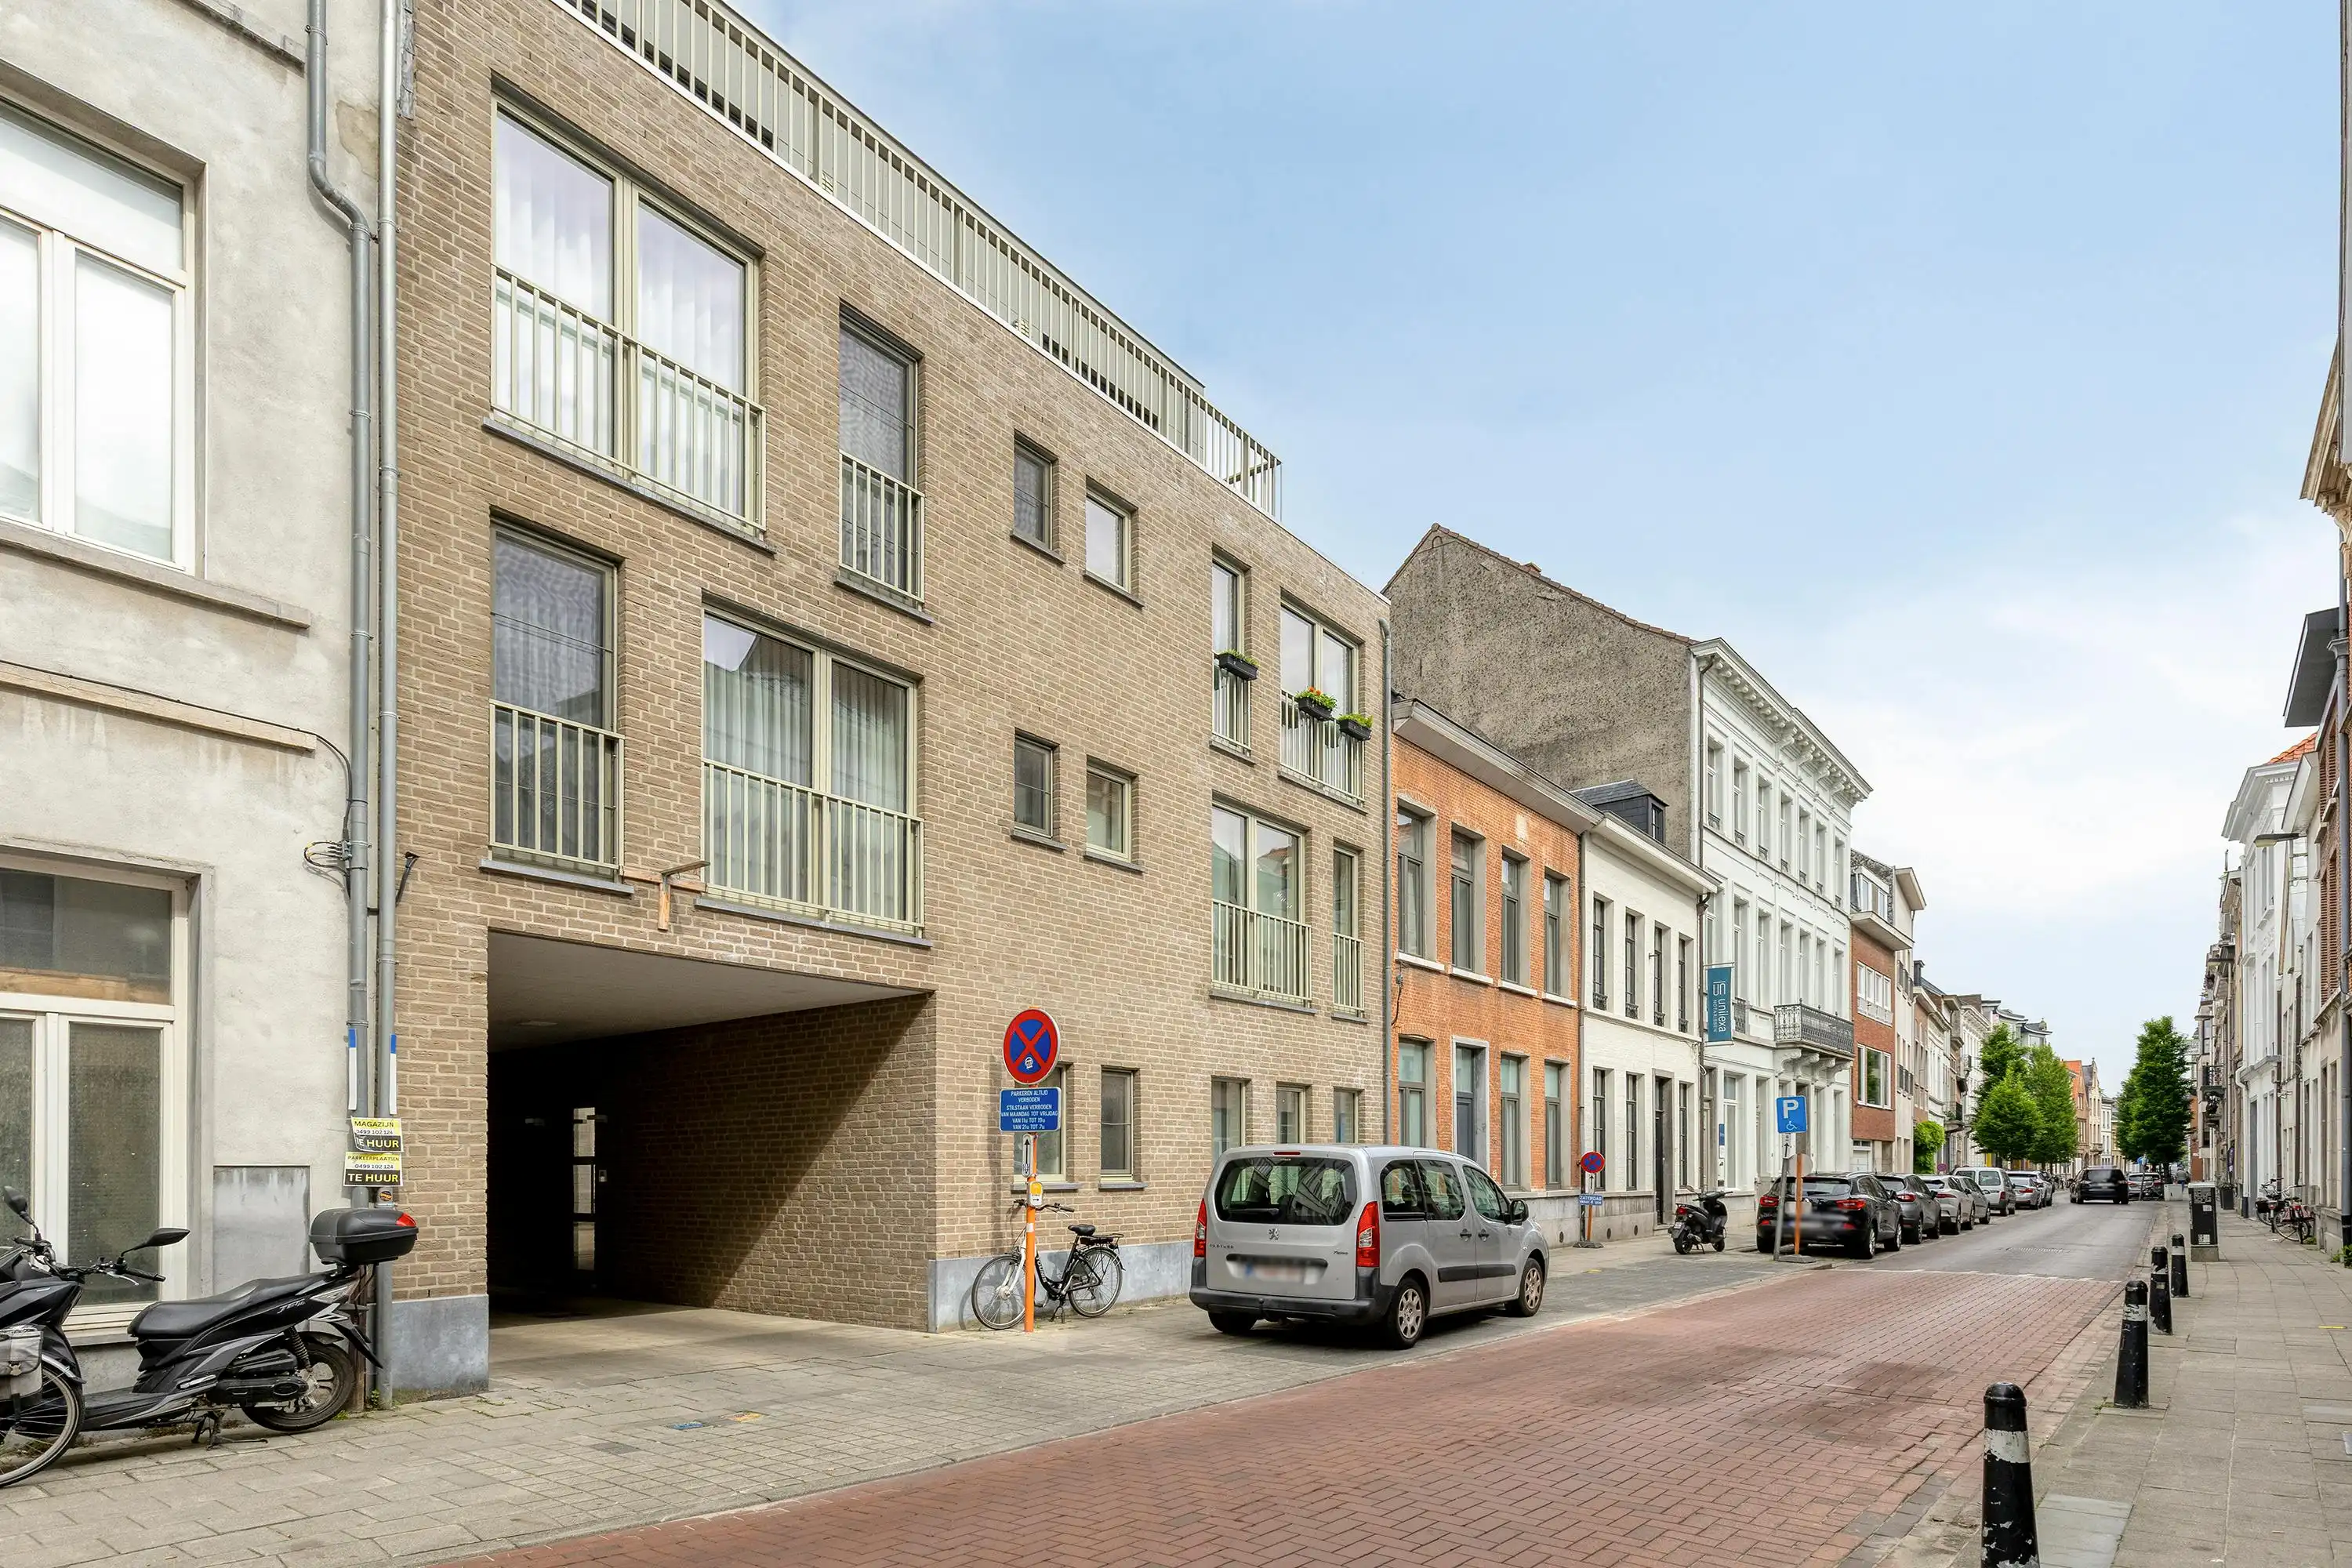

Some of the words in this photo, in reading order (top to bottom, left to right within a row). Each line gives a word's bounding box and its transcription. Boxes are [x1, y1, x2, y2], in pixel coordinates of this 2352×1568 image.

[1718, 999, 1729, 1032] unilexa
[1783, 1099, 1799, 1119] P
[356, 1137, 364, 1146] TE
[366, 1174, 398, 1182] HUUR
